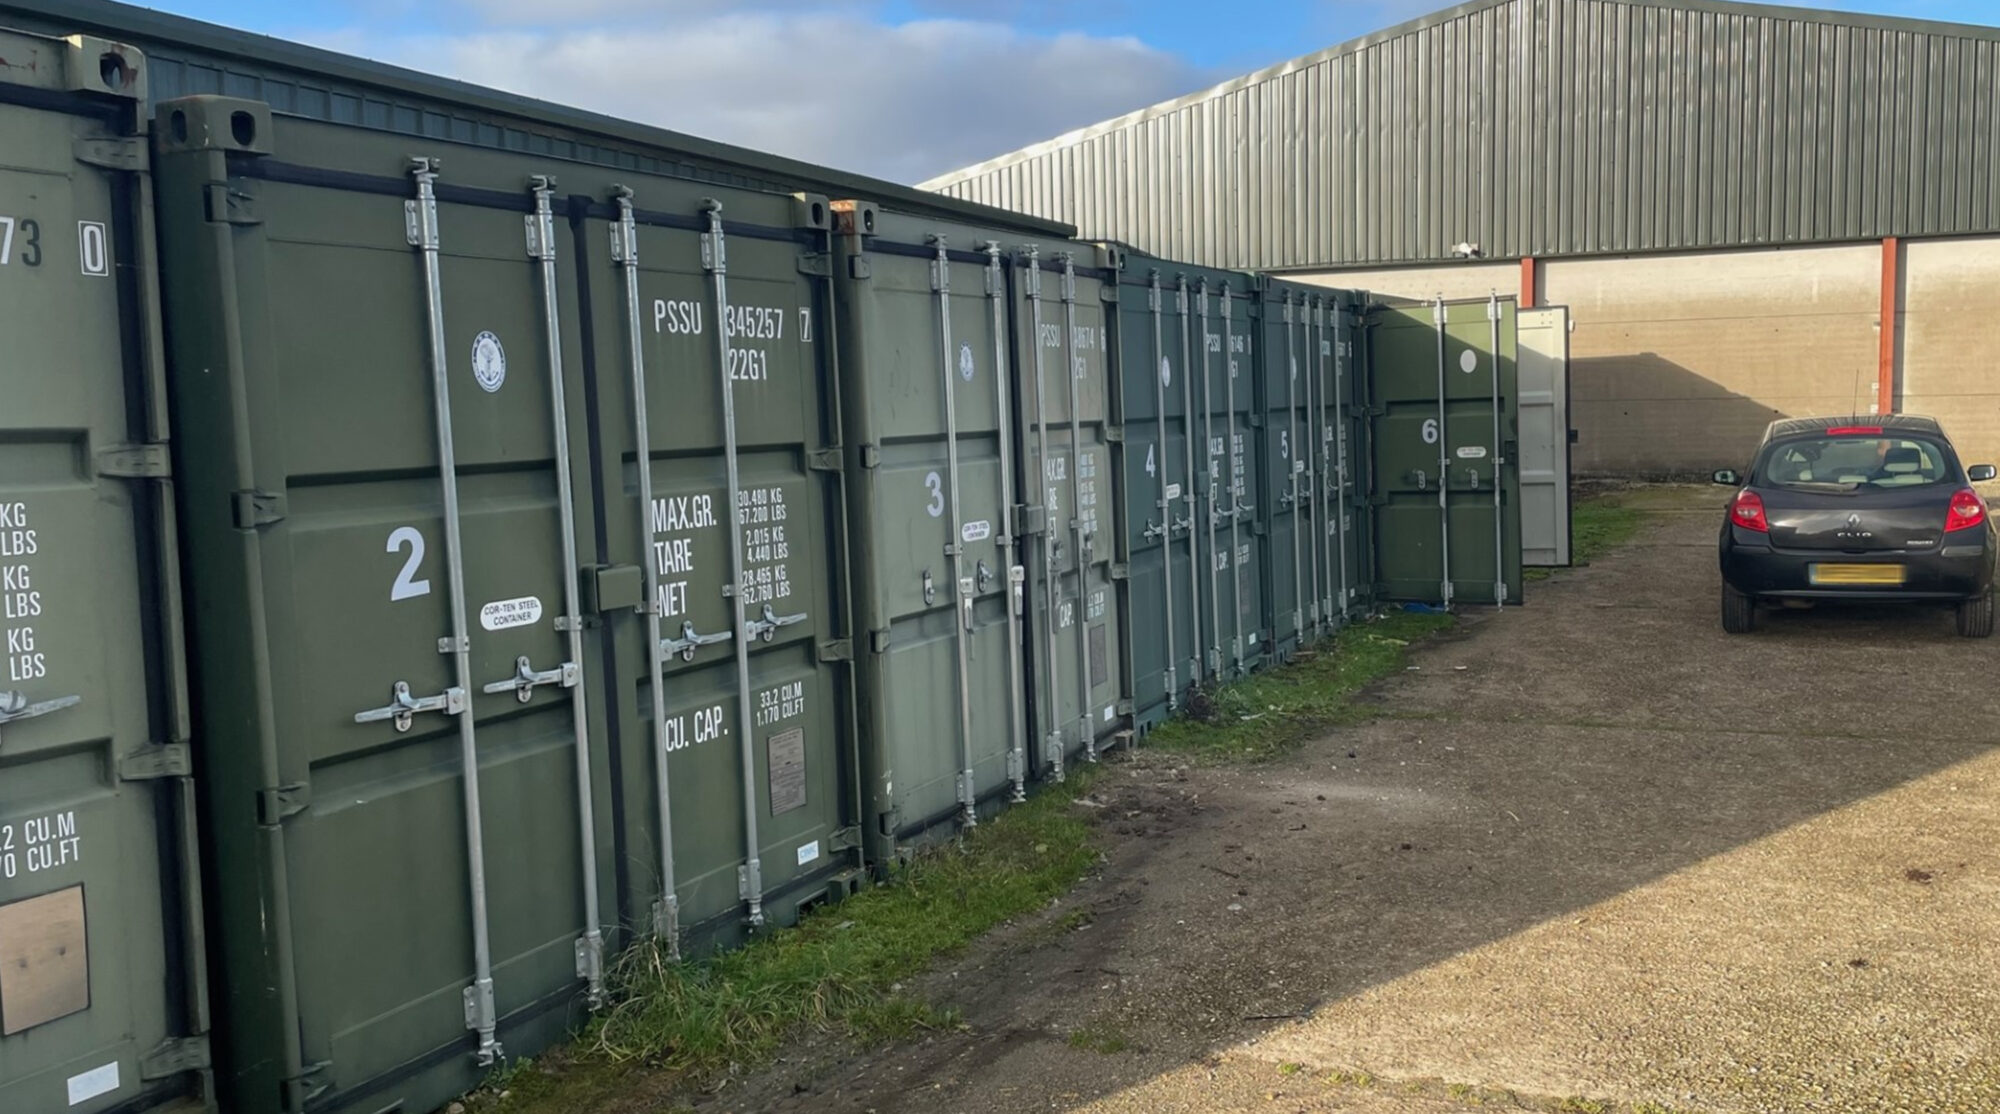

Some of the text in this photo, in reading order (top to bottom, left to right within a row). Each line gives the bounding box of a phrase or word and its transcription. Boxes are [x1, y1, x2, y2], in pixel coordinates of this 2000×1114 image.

[82, 224, 106, 273] 0
[654, 299, 810, 340] PSSU 345257 7
[729, 348, 767, 380] 22G1
[1281, 430, 1289, 459] 5
[1422, 418, 1438, 444] 6
[1145, 443, 1156, 478] 4
[738, 487, 783, 507] 30.480 KG
[925, 471, 944, 517] 3
[0, 502, 27, 528] KG
[651, 494, 718, 533] MAX.GR.
[771, 504, 787, 521] LBS
[0, 530, 38, 556] LBS
[745, 526, 784, 546] 2.015 KG
[386, 526, 431, 601] 2
[653, 538, 694, 575] TARE
[747, 542, 789, 563] 4.440 LBS
[3, 565, 31, 591] KG
[743, 564, 786, 586] 28.465 KG
[5, 591, 42, 619] LBS
[658, 581, 688, 618] NET
[744, 581, 791, 604] 62.760 LBS
[484, 599, 539, 616] COR-TEN STEEL
[493, 611, 532, 626] CONTAINER
[7, 627, 35, 654] KG
[9, 653, 47, 681] LBS
[760, 681, 803, 708] 33.2 CU.M
[756, 697, 805, 727] 1.170 CU.FT
[665, 705, 729, 752] CU. CAP.
[24, 811, 76, 845] CU.M
[26, 836, 81, 872] CU.FT
